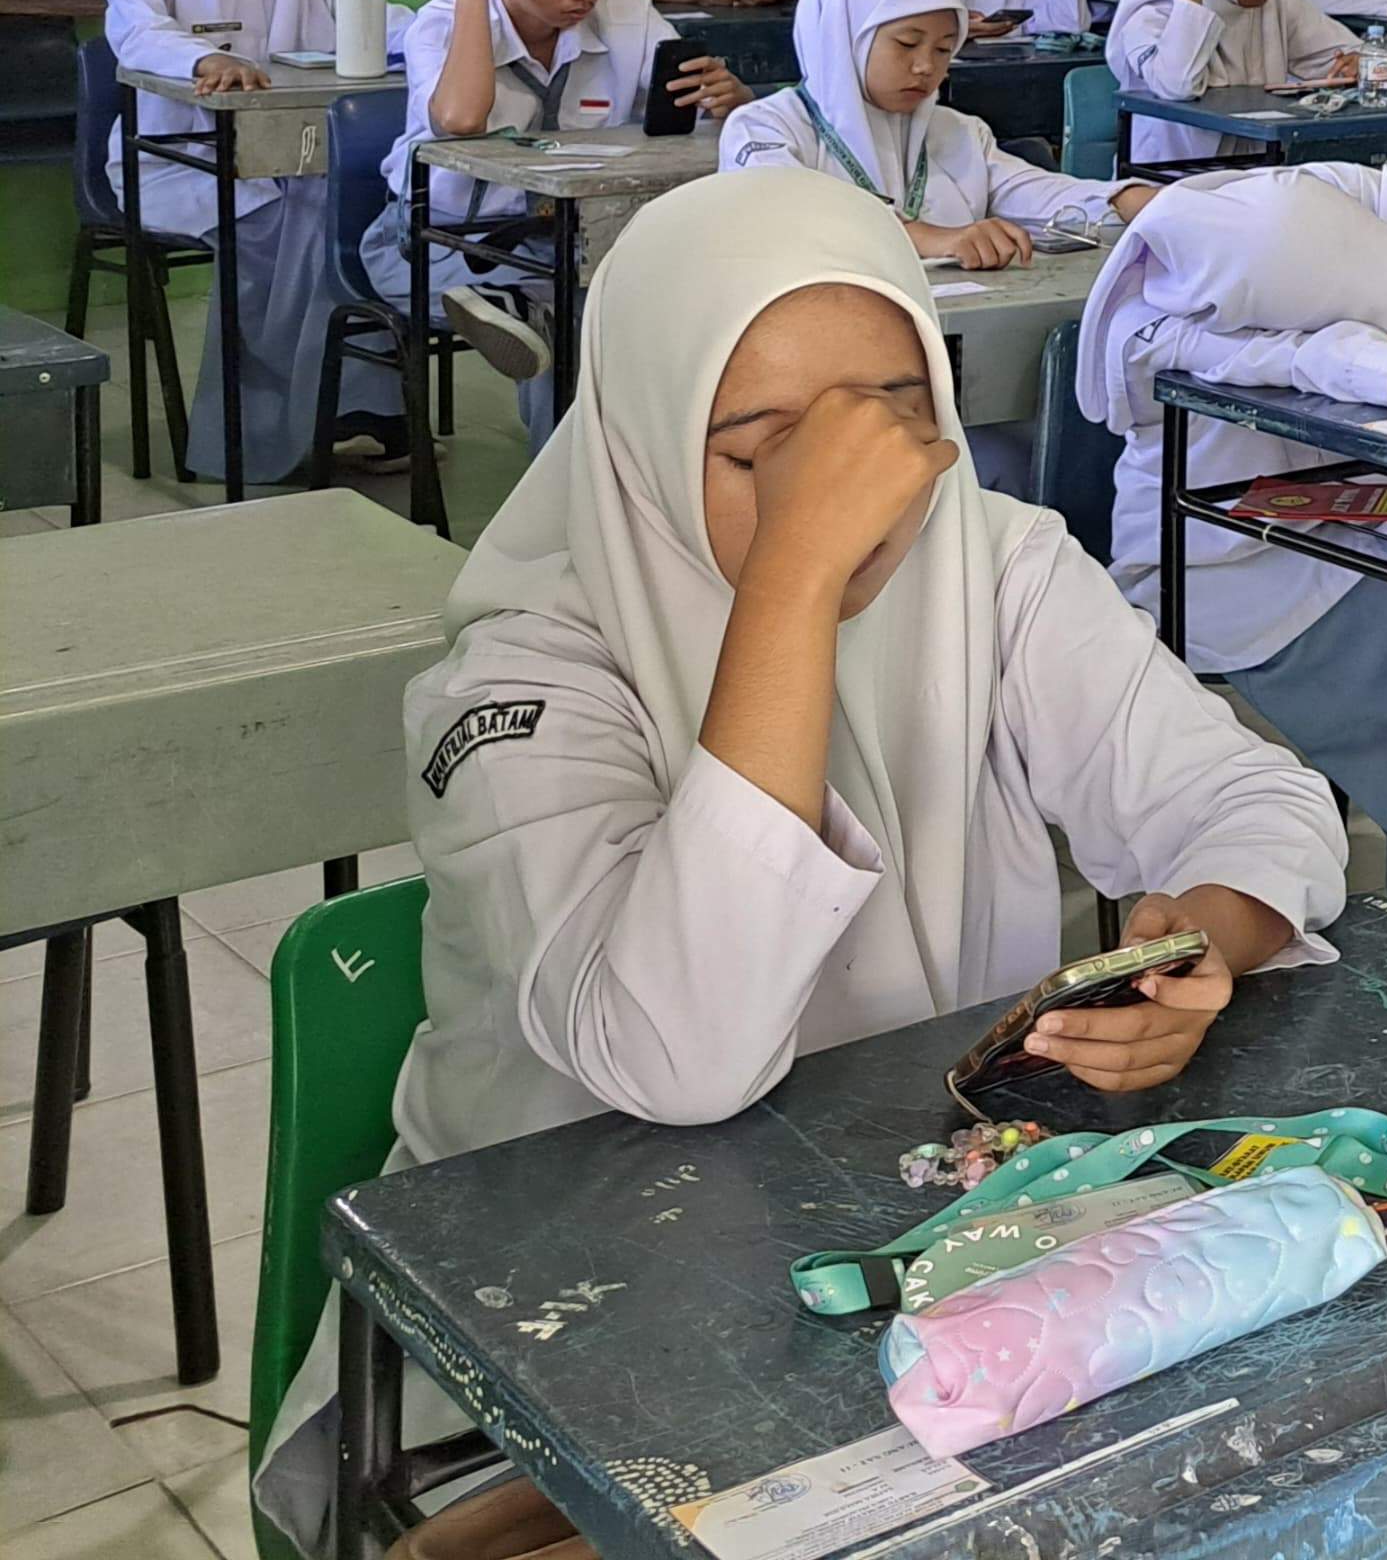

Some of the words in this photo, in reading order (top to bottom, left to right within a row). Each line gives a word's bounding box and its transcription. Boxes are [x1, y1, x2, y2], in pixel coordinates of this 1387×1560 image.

[444, 718, 475, 759] FILIAL
[477, 706, 536, 737] BATAM
[943, 1224, 1021, 1253] WAY
